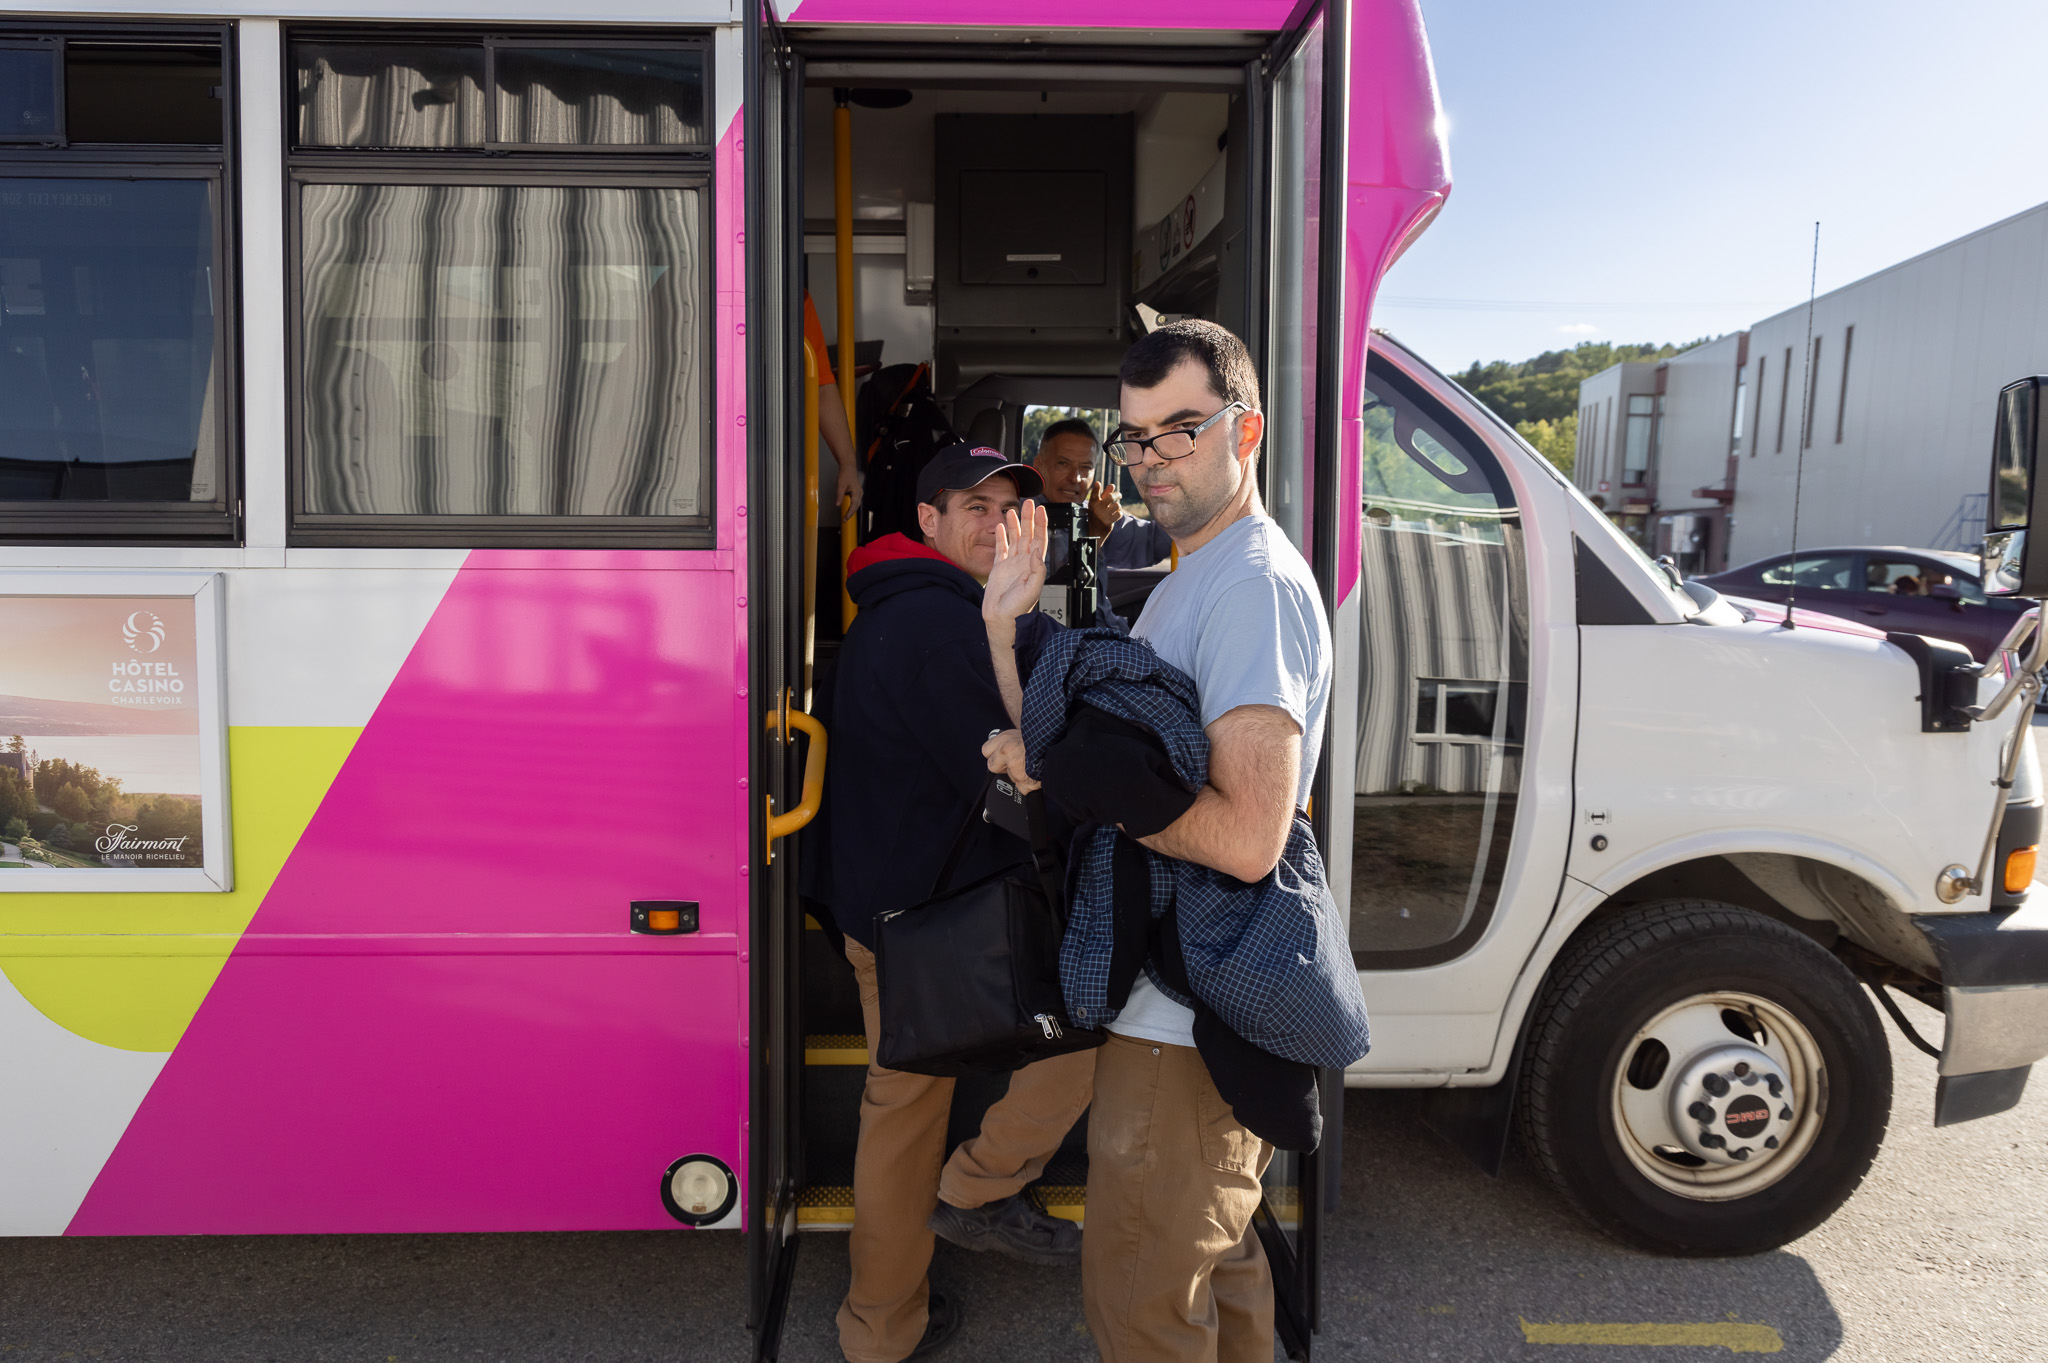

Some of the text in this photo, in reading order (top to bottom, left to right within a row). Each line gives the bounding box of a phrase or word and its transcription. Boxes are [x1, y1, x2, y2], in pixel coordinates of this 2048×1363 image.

[112, 659, 179, 676] HÔTEL
[108, 678, 184, 693] CASINO
[111, 696, 182, 705] CHARLEVOIX
[95, 823, 190, 854] Fairmont
[1726, 1109, 1769, 1124] GMC
